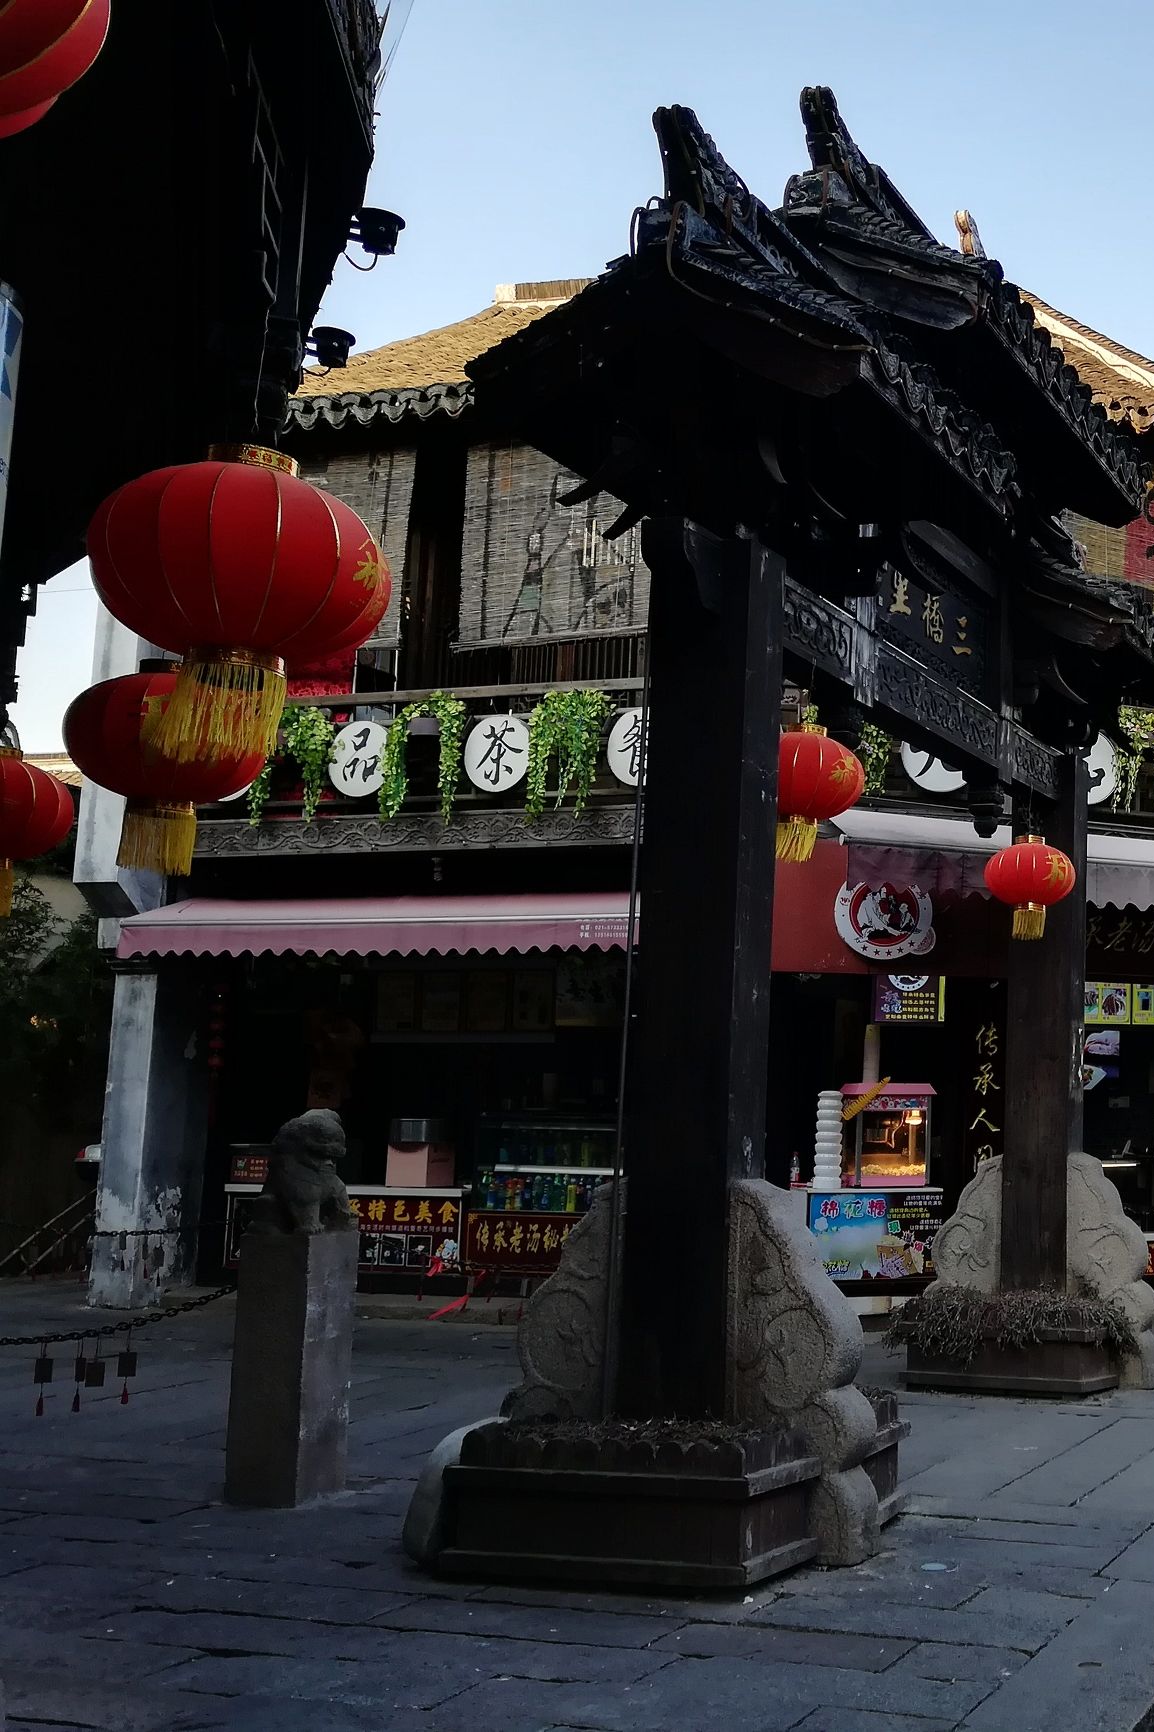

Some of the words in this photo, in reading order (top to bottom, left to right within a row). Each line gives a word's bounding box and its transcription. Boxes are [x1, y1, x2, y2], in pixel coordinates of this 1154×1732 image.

[475, 720, 524, 786] 茶
[820, 1199, 887, 1219] 棉花糖
